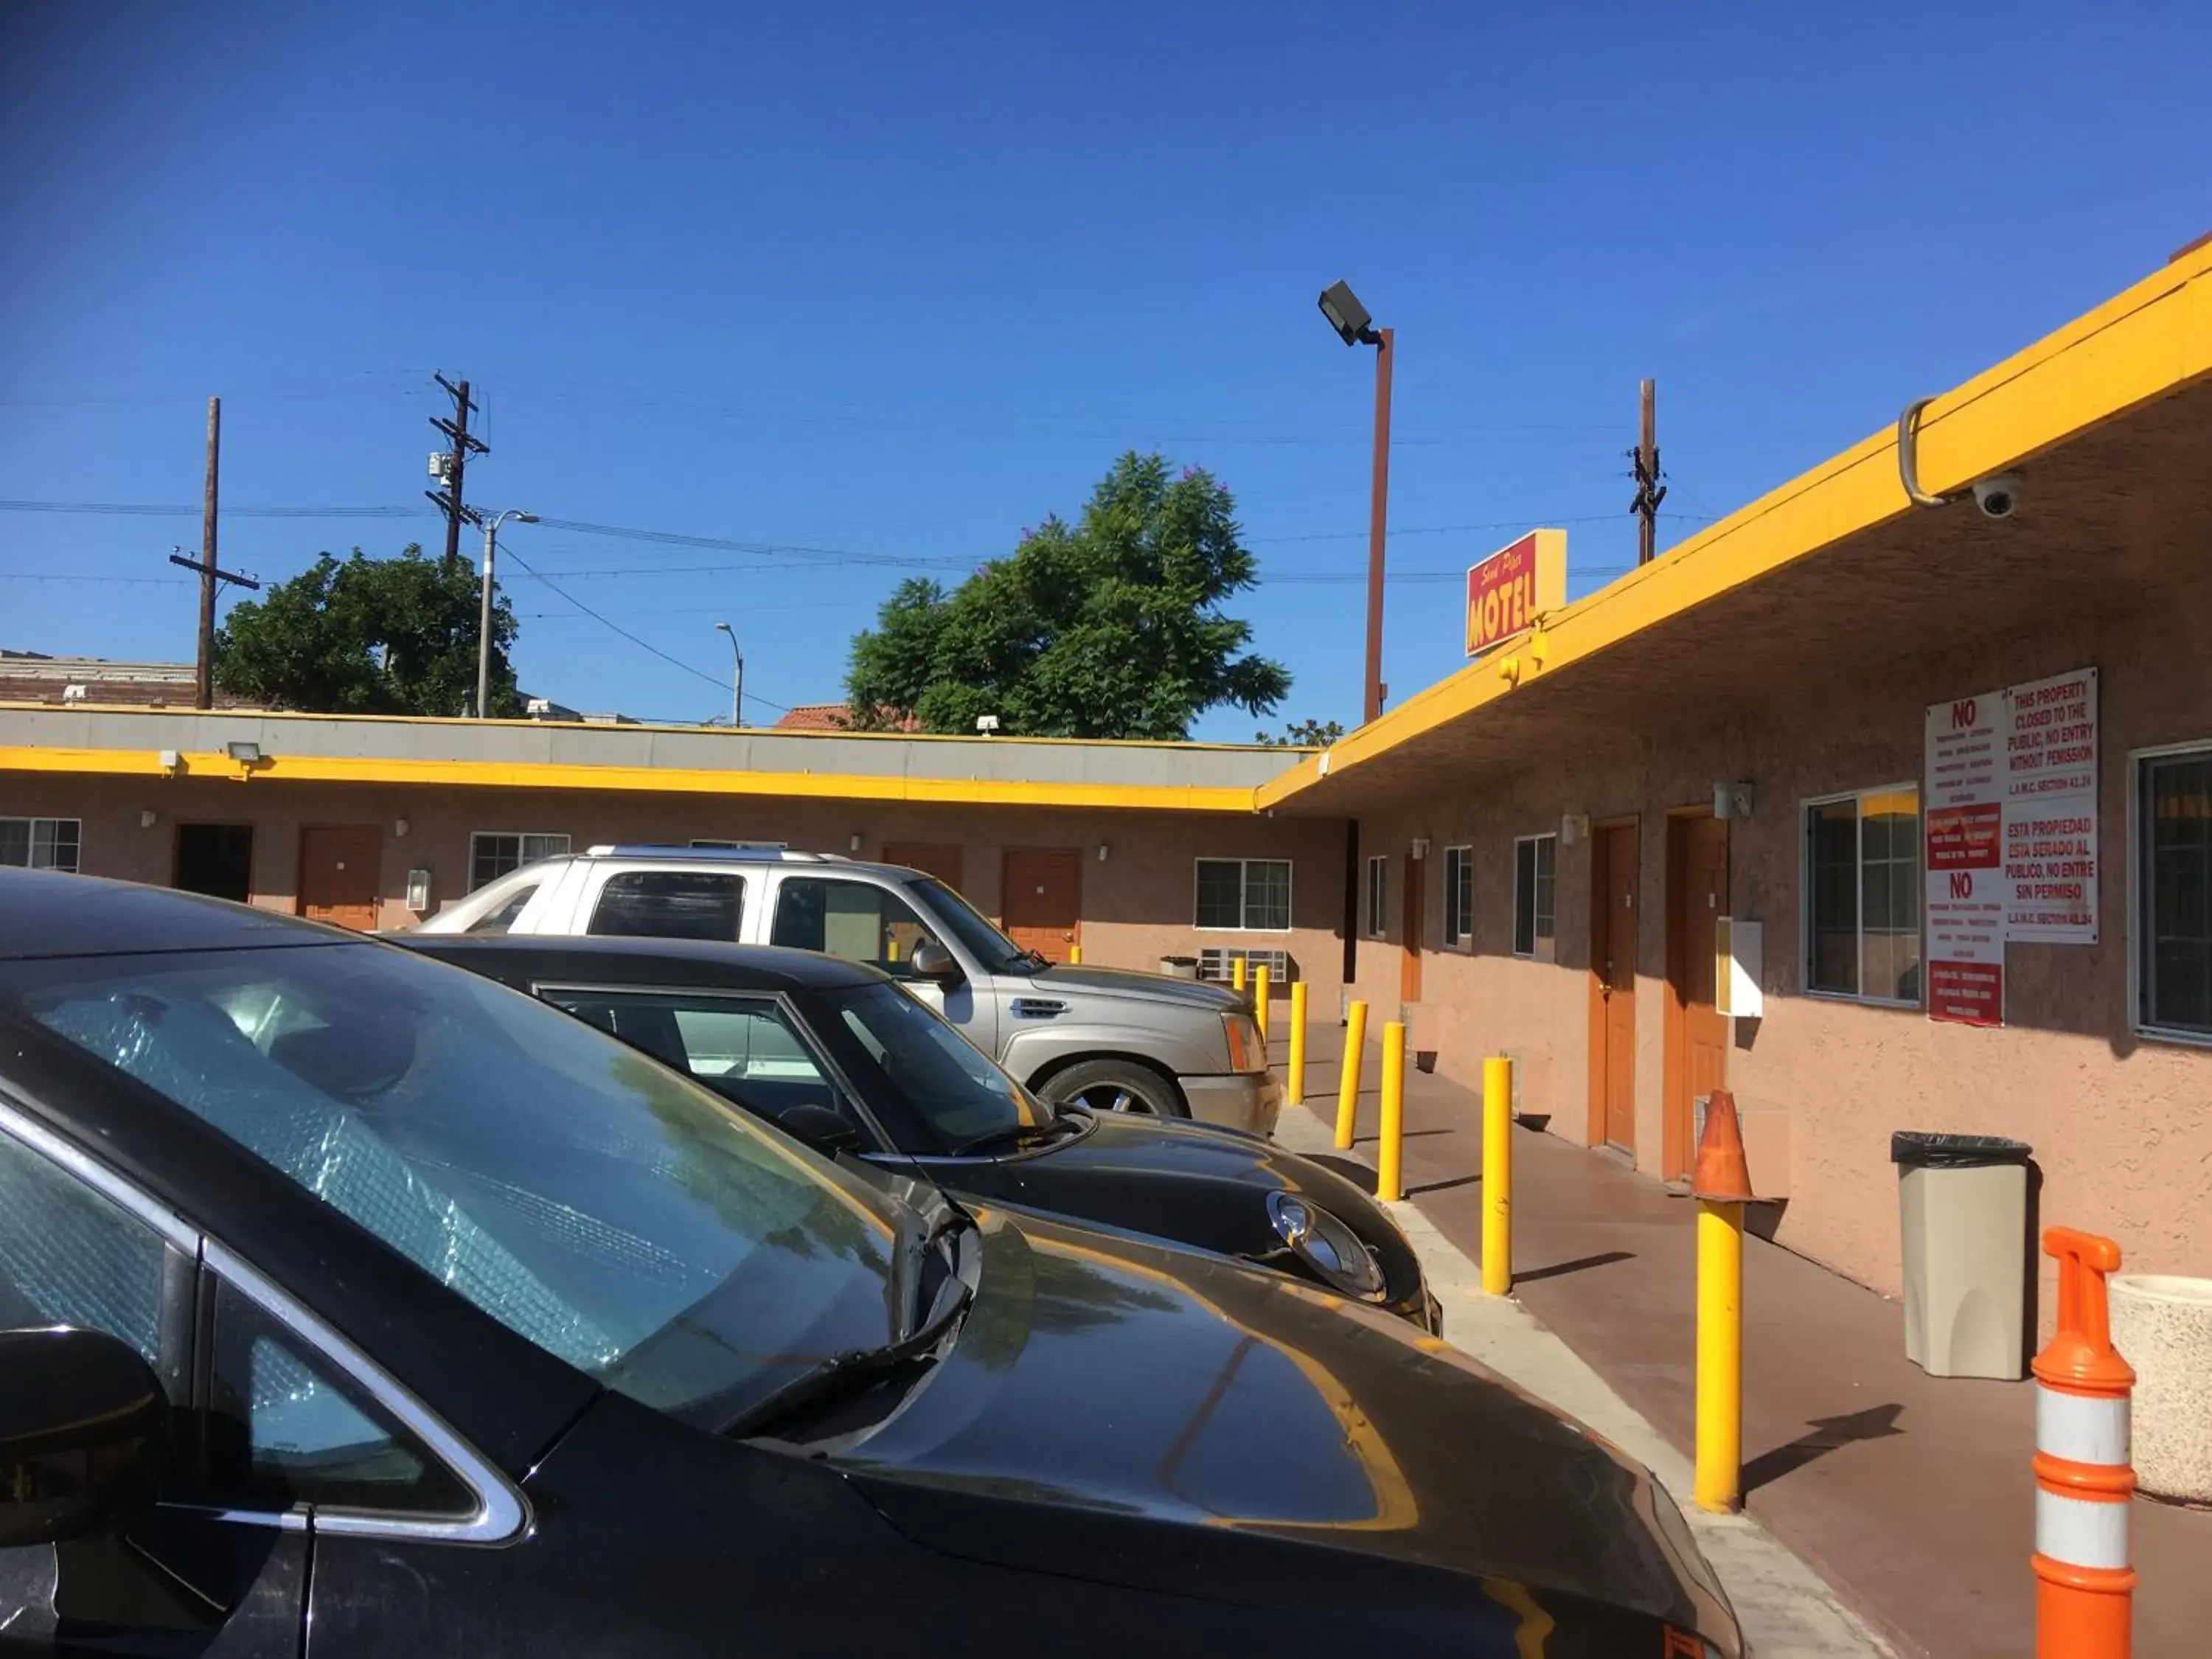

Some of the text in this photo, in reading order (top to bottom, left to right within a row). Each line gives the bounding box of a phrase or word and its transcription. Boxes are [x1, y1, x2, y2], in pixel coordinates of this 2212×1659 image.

[1468, 571, 1537, 649] MOTEL
[2014, 680, 2087, 711] THIS PROPERTY
[1952, 699, 1976, 729] NO
[2016, 702, 2086, 730] CLOSED TO THE
[2046, 729, 2059, 745] NO
[2062, 723, 2093, 742] ENTRY
[2010, 752, 2043, 771] WITHOUT
[2037, 777, 2067, 792] SECTION
[2032, 818, 2092, 836] PROPIEDAD
[2076, 839, 2090, 856] AL
[2046, 862, 2059, 878] NO
[2062, 860, 2095, 878] ENTRE
[1950, 872, 1972, 899] NO
[2016, 883, 2081, 900] SIN PERMISO
